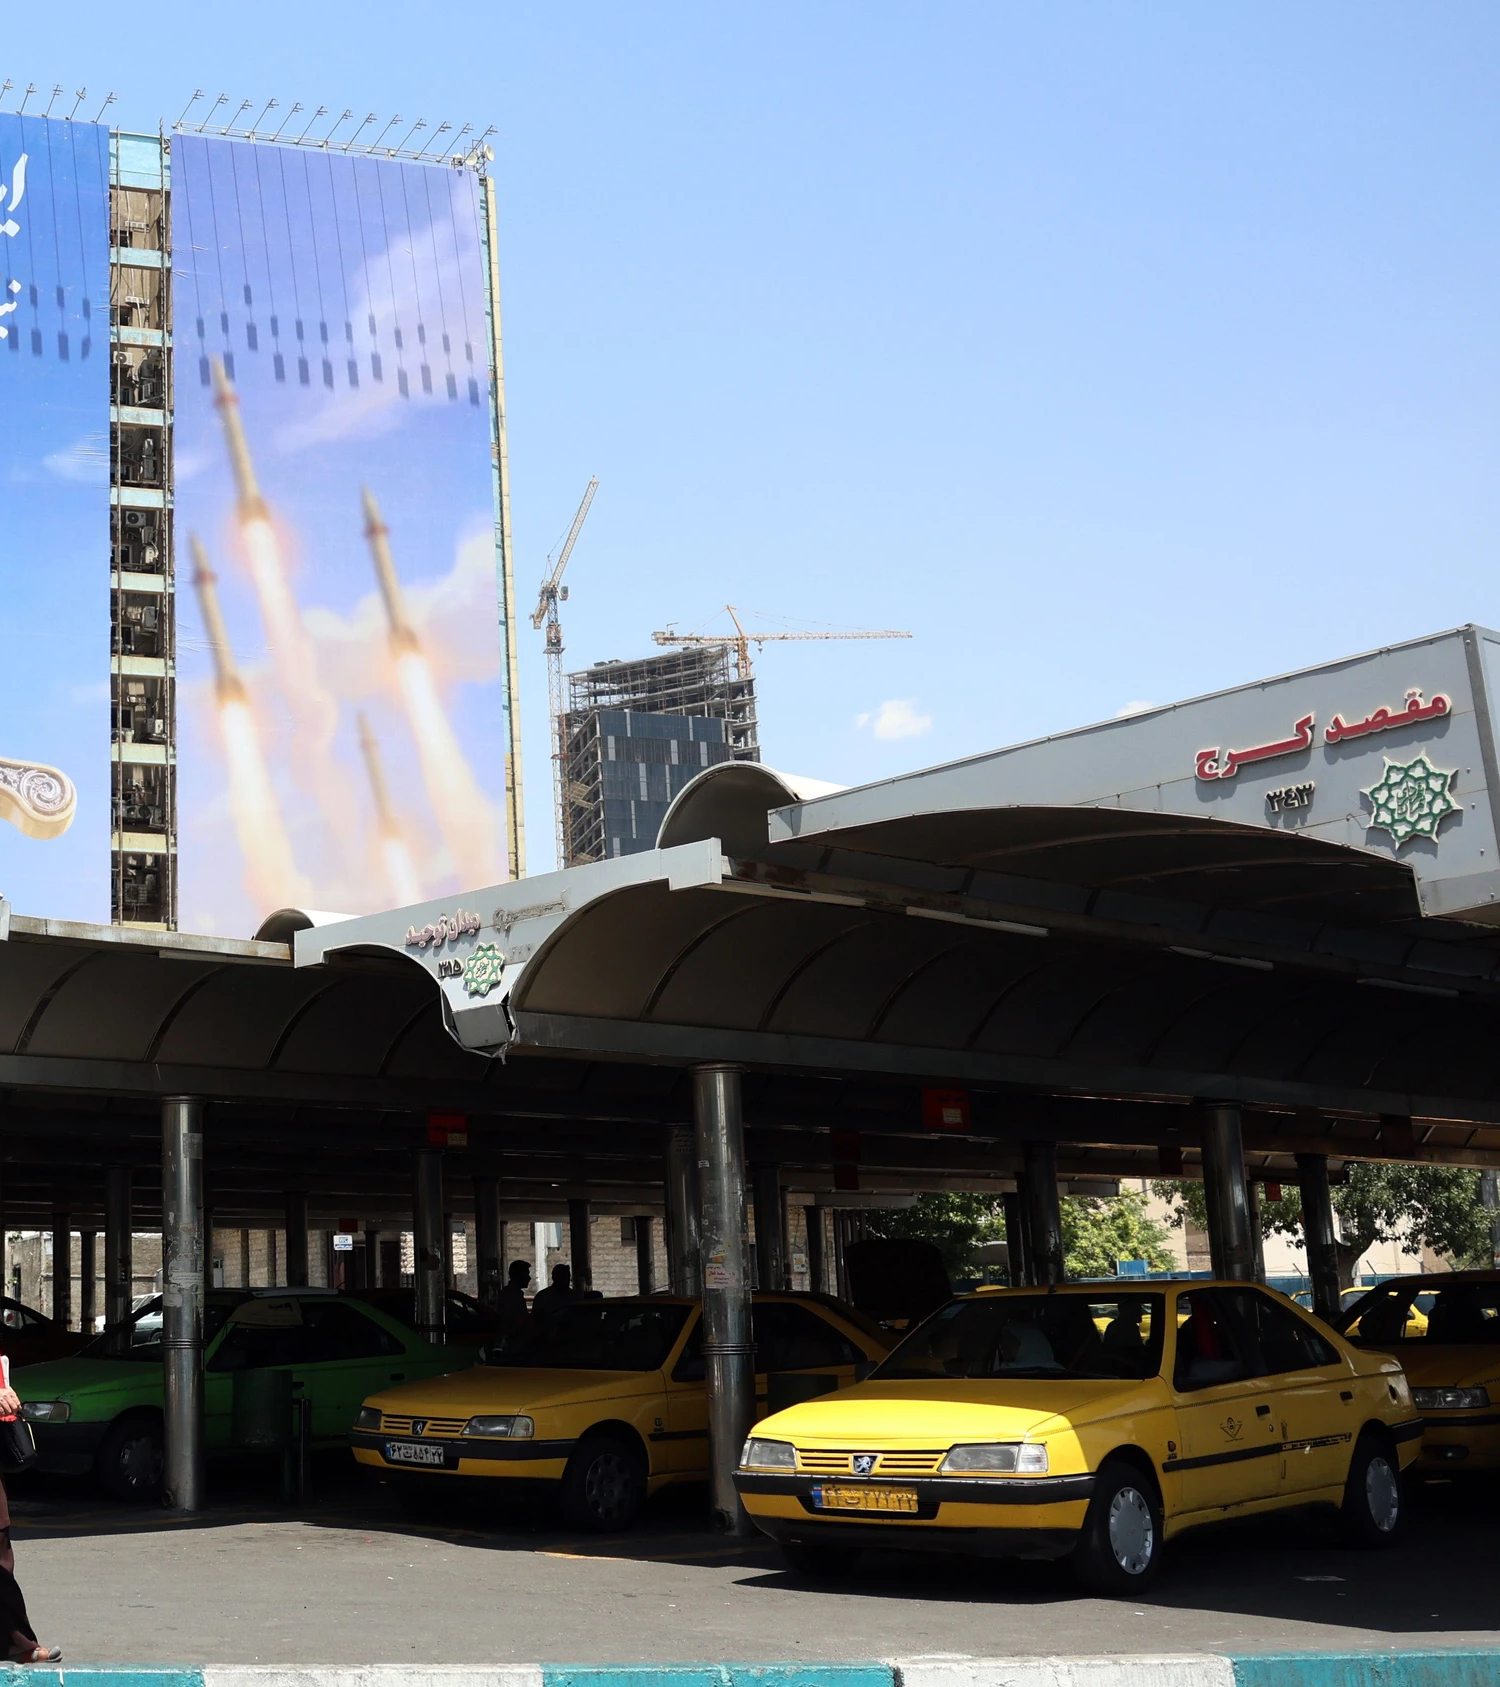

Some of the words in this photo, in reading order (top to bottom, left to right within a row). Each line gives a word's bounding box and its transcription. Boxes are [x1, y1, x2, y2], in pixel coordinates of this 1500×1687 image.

[1324, 687, 1452, 744] مقصد
[1194, 712, 1316, 781] کرج
[405, 915, 448, 948] توحید
[447, 908, 480, 941] میدان
